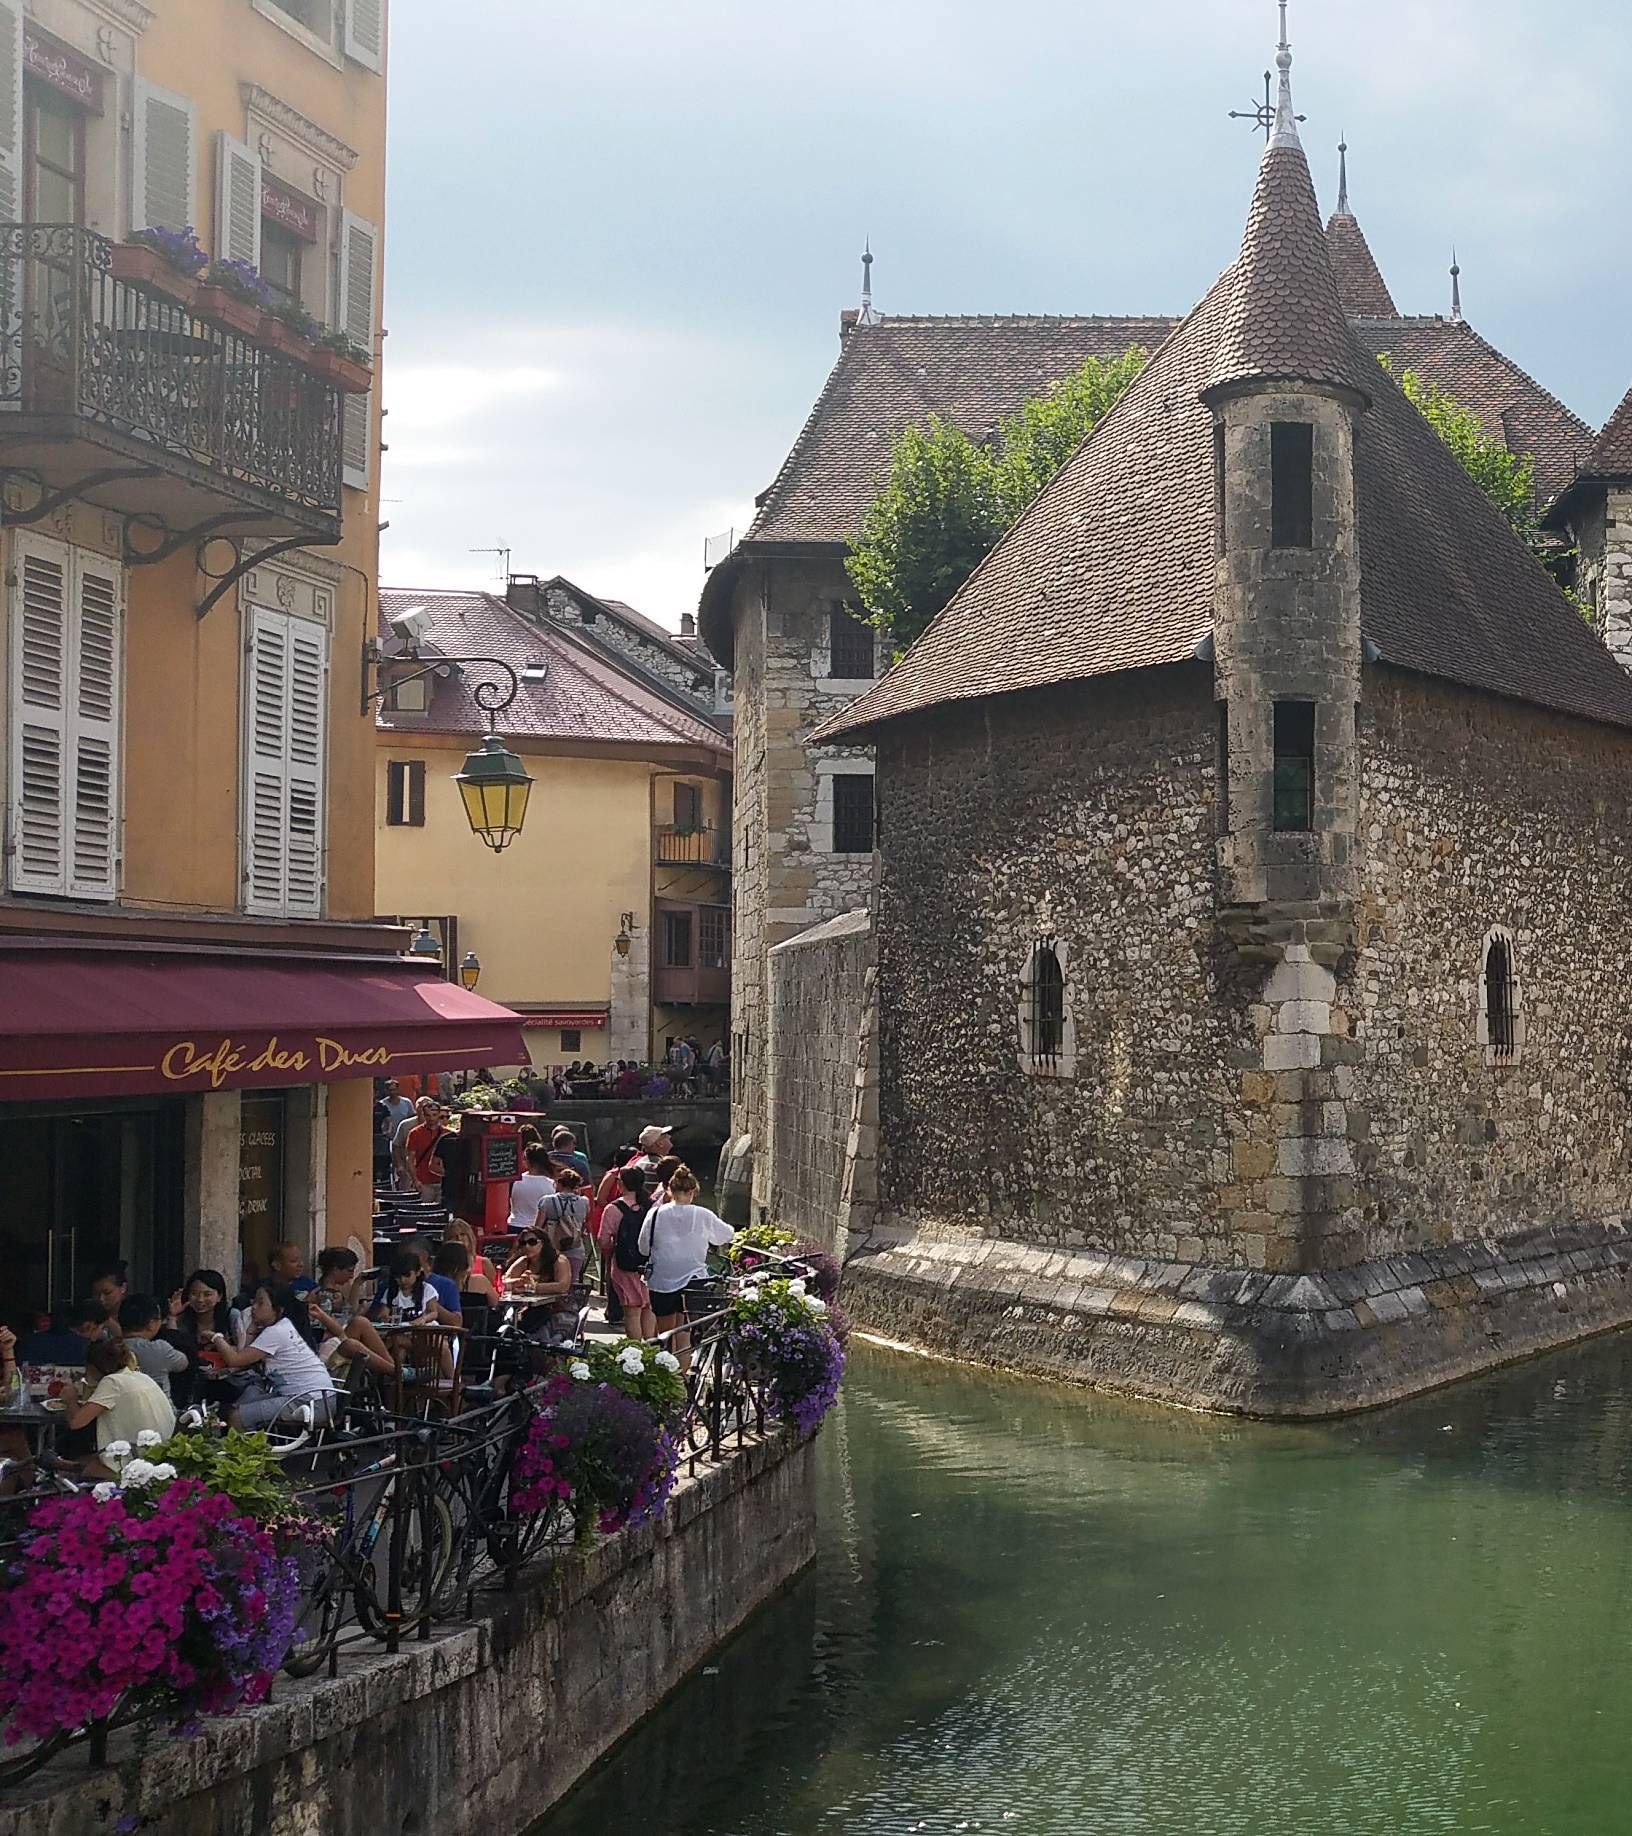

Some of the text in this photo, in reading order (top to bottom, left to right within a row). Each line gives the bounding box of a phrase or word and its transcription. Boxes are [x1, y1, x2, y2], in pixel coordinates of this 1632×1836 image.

[161, 1036, 392, 1088] Café des Ducs
